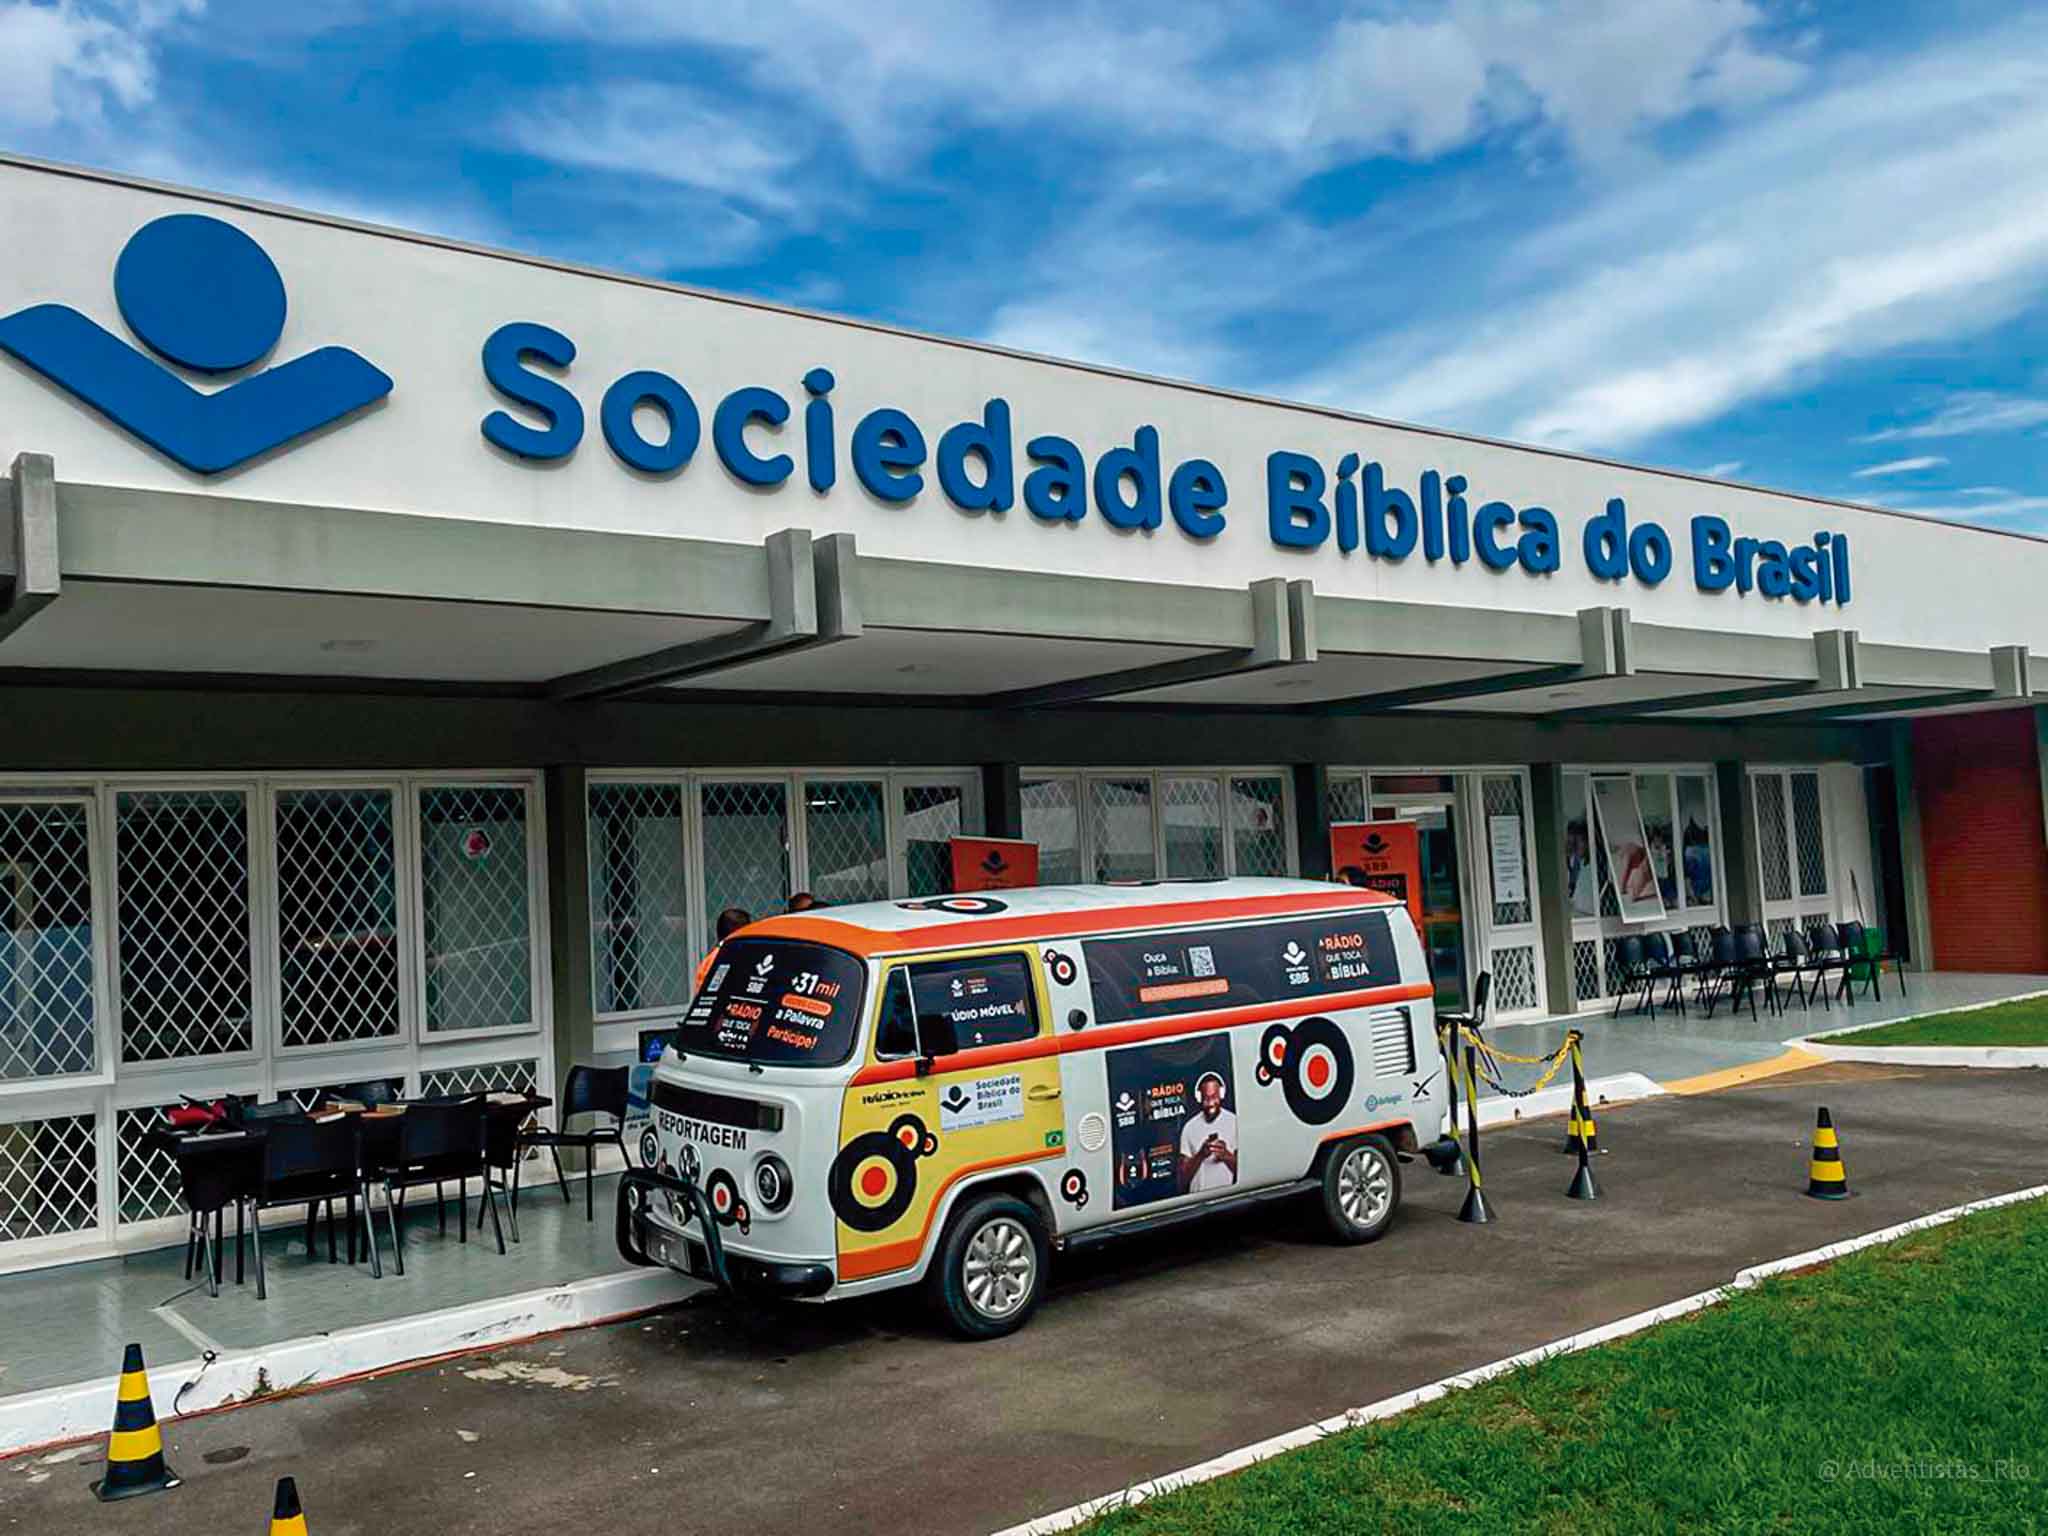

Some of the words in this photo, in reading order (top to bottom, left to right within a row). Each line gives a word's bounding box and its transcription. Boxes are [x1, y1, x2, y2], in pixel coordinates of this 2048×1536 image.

[481, 321, 1228, 539] Sociedade
[1267, 451, 1560, 576] Bíblica
[1583, 498, 1672, 585] do
[1691, 515, 1851, 605] Brasil
[1325, 934, 1363, 949] RÁDIO
[1331, 962, 1370, 980] BÍBLIA
[976, 1076, 1021, 1090] Sociedade
[978, 1098, 1003, 1111] Brasil
[659, 1112, 747, 1150] REPORTAGEM
